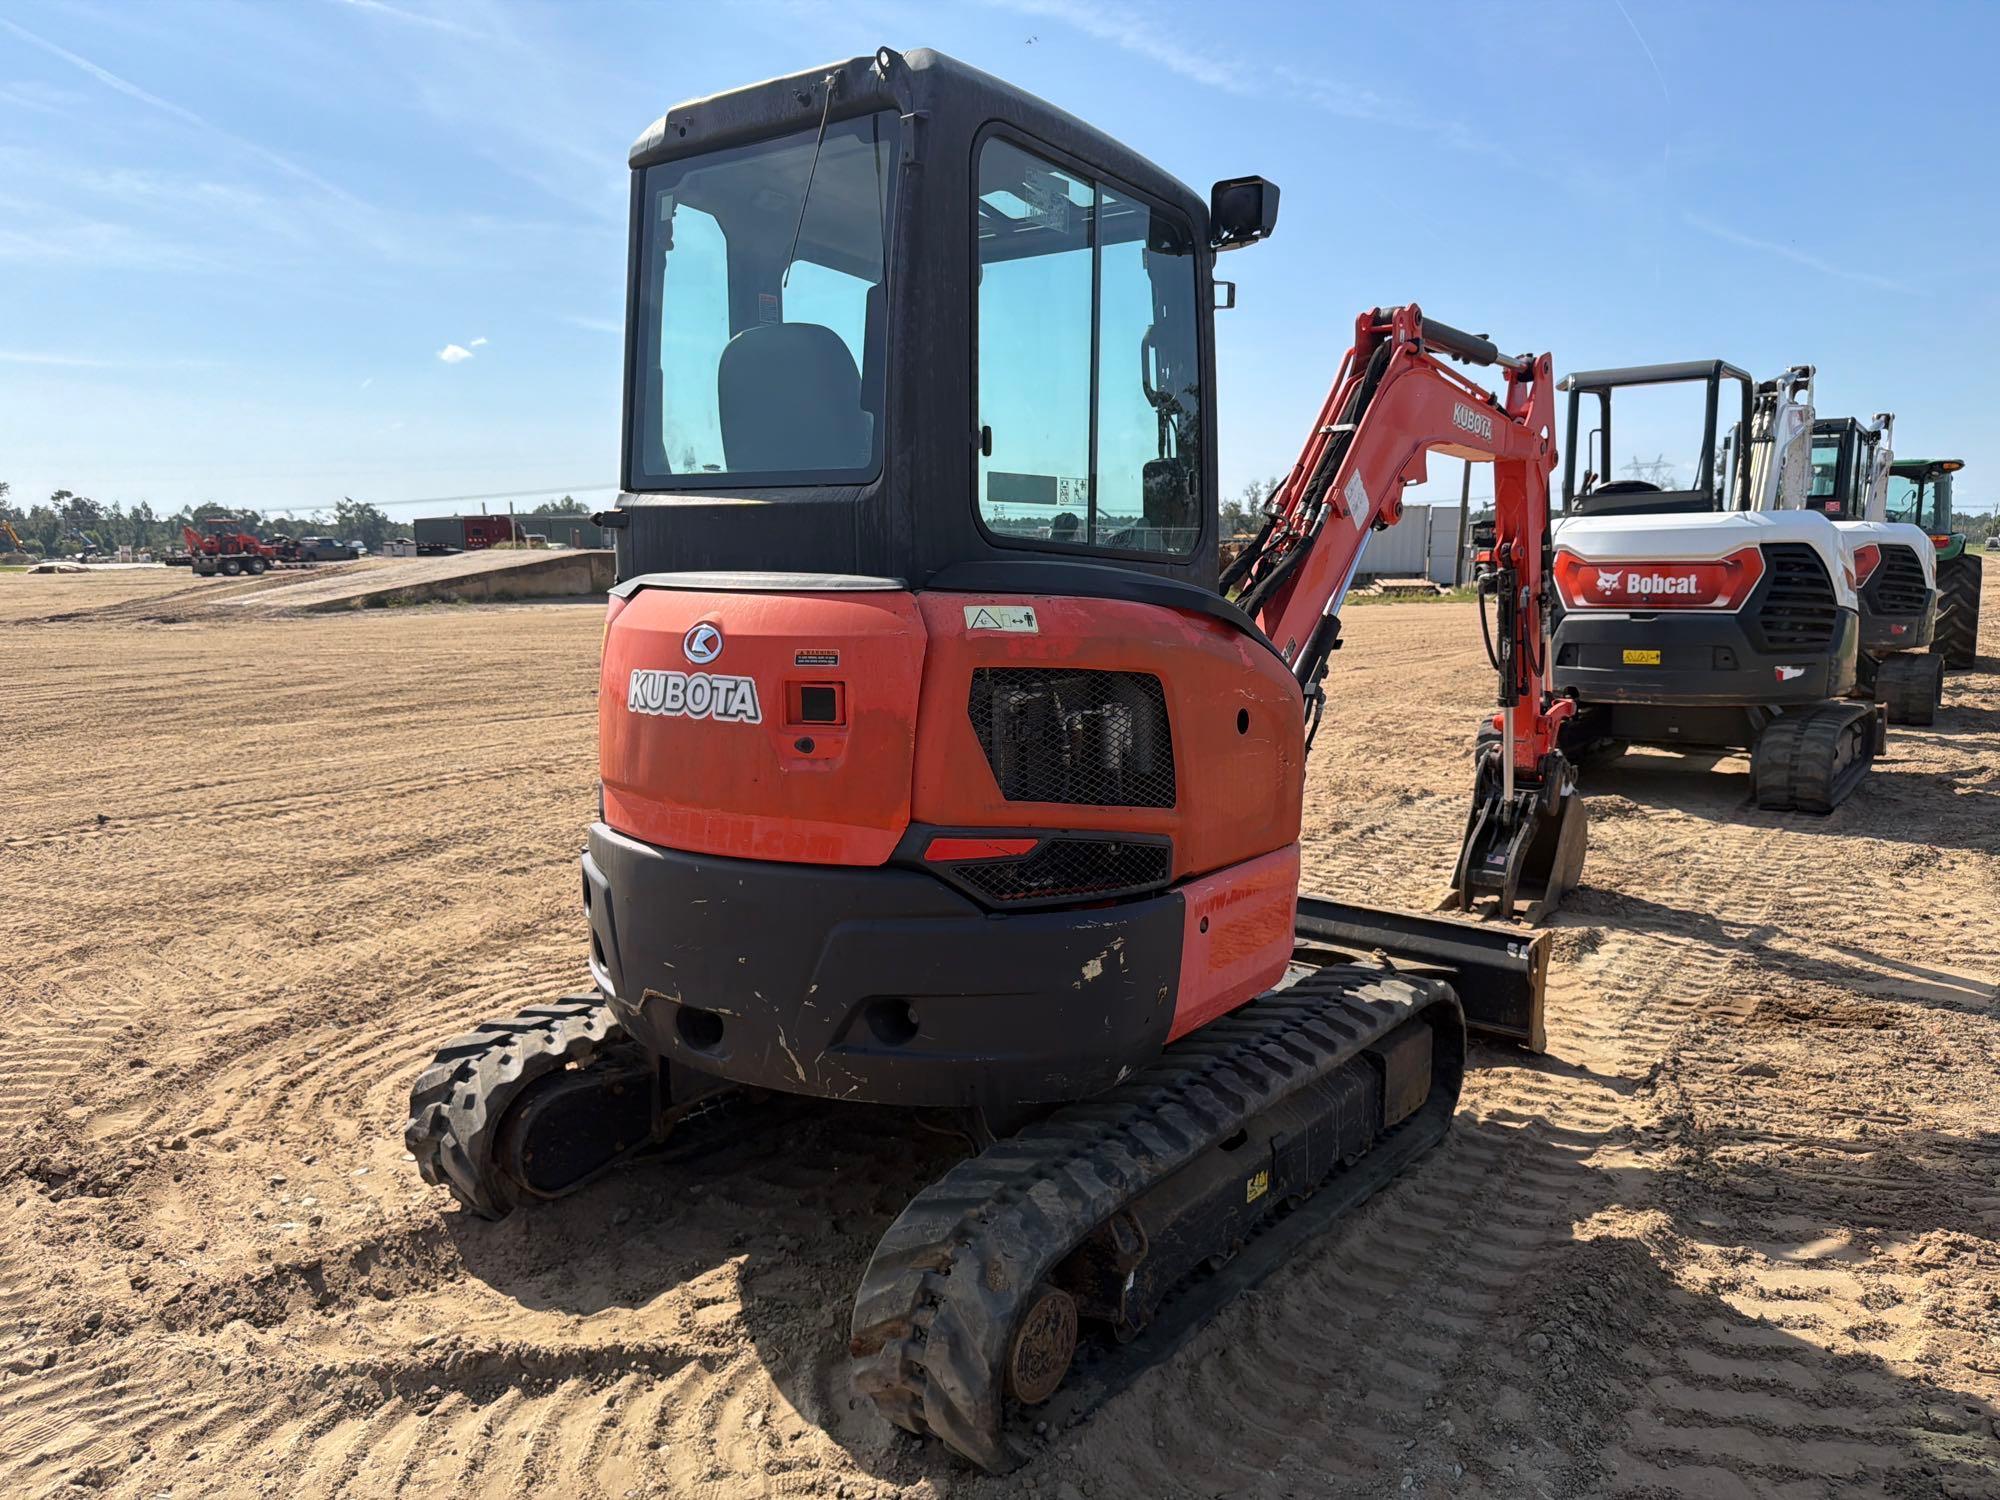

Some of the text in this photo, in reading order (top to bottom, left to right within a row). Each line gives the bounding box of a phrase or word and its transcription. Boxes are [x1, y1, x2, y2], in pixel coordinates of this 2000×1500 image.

[1453, 402, 1492, 440] KUBOTA
[1626, 573, 1697, 594] Bobcat
[628, 671, 760, 721] KUBOTA
